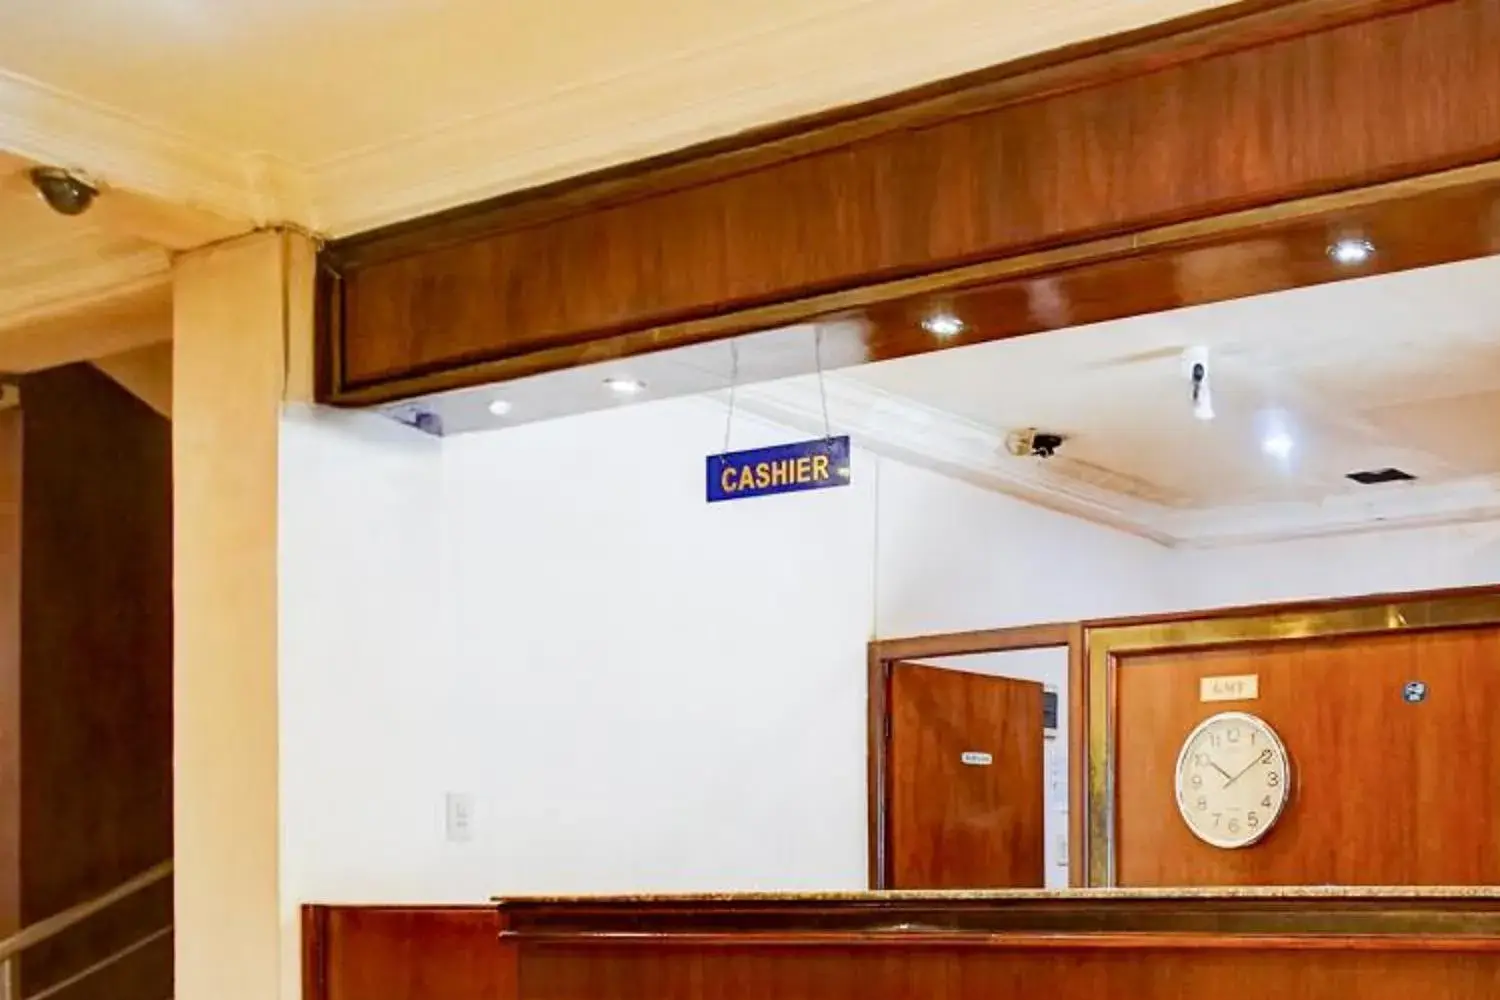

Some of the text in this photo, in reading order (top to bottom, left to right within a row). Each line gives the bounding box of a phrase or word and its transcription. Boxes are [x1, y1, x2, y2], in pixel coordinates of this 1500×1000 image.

[721, 455, 829, 492] CASHIER
[1261, 749, 1273, 765] 2
[1267, 771, 1279, 787] 3
[1261, 795, 1271, 808] 4
[1211, 812, 1222, 827] 7
[1228, 818, 1240, 833] 6
[1247, 811, 1259, 827] 5
